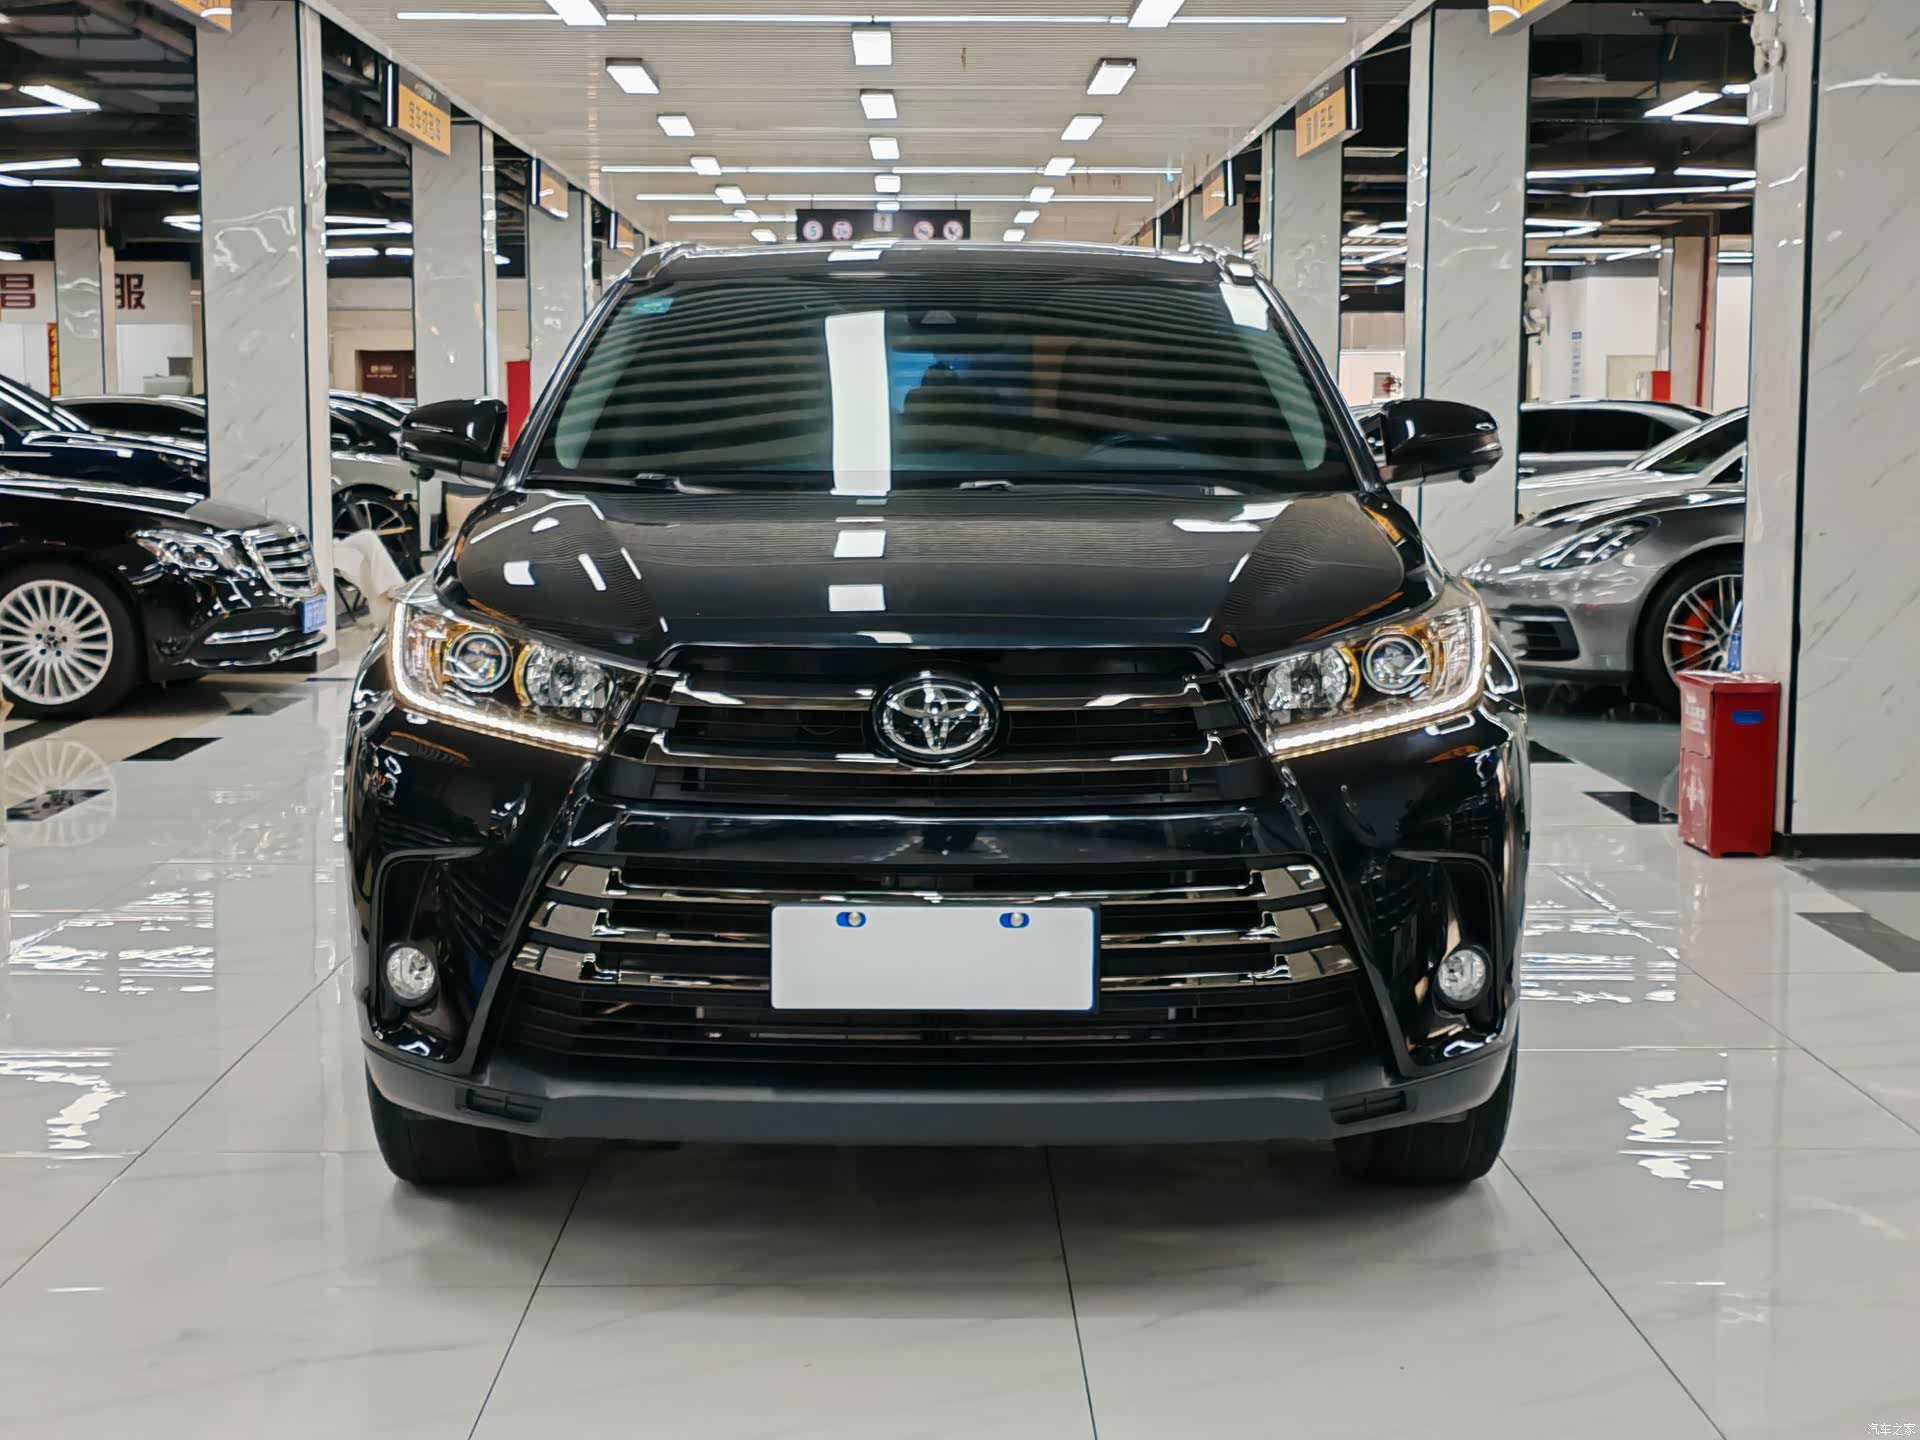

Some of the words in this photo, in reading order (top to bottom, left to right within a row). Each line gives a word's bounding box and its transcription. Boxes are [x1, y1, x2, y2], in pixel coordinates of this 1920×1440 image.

[809, 225, 817, 237] 5
[0, 273, 36, 309] 昌
[115, 273, 146, 310] 服
